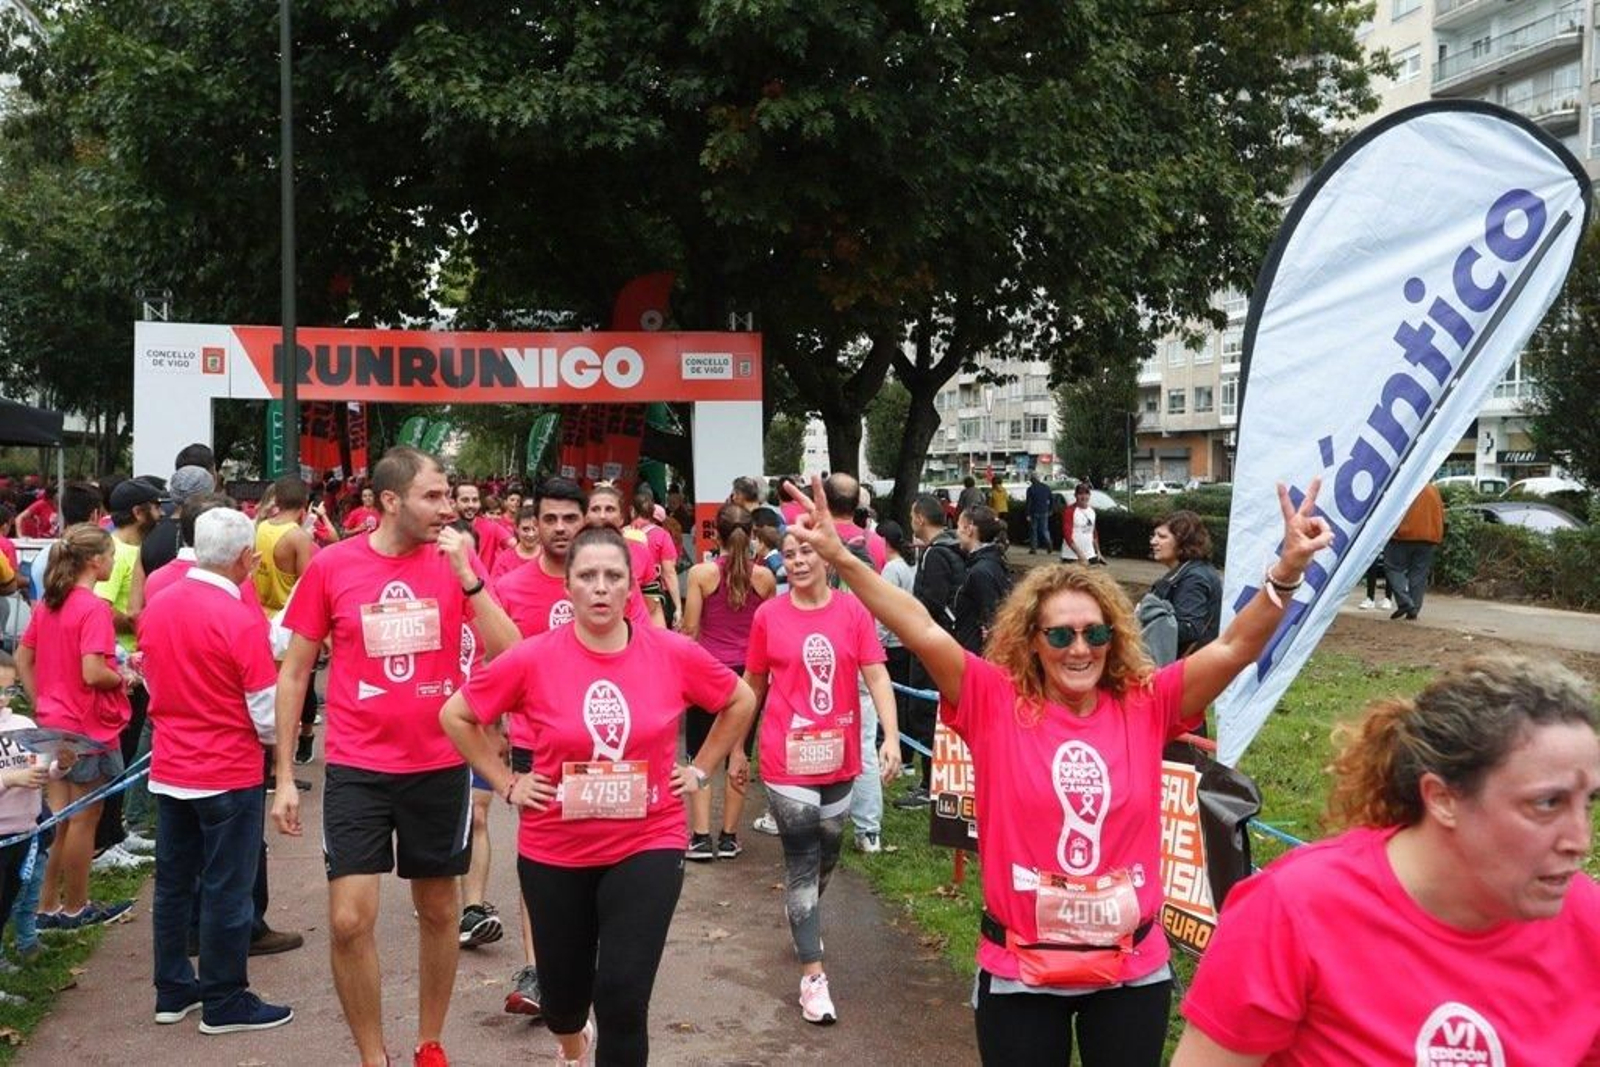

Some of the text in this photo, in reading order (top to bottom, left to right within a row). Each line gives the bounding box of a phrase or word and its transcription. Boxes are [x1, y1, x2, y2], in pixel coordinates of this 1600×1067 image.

[146, 349, 196, 359] CONCELLO
[152, 358, 190, 368] DE VIGO
[685, 358, 729, 366] CONCELLO
[690, 366, 724, 374] DE VIGO
[380, 617, 426, 640] 2705
[595, 687, 611, 699] VI
[799, 744, 833, 762] 3995
[1067, 749, 1086, 763] VI
[1061, 767, 1101, 778] VIGO
[581, 780, 630, 804] 4793
[1057, 898, 1121, 925] 4000
[1163, 908, 1213, 950] EURO
[1442, 1021, 1476, 1049] VI
